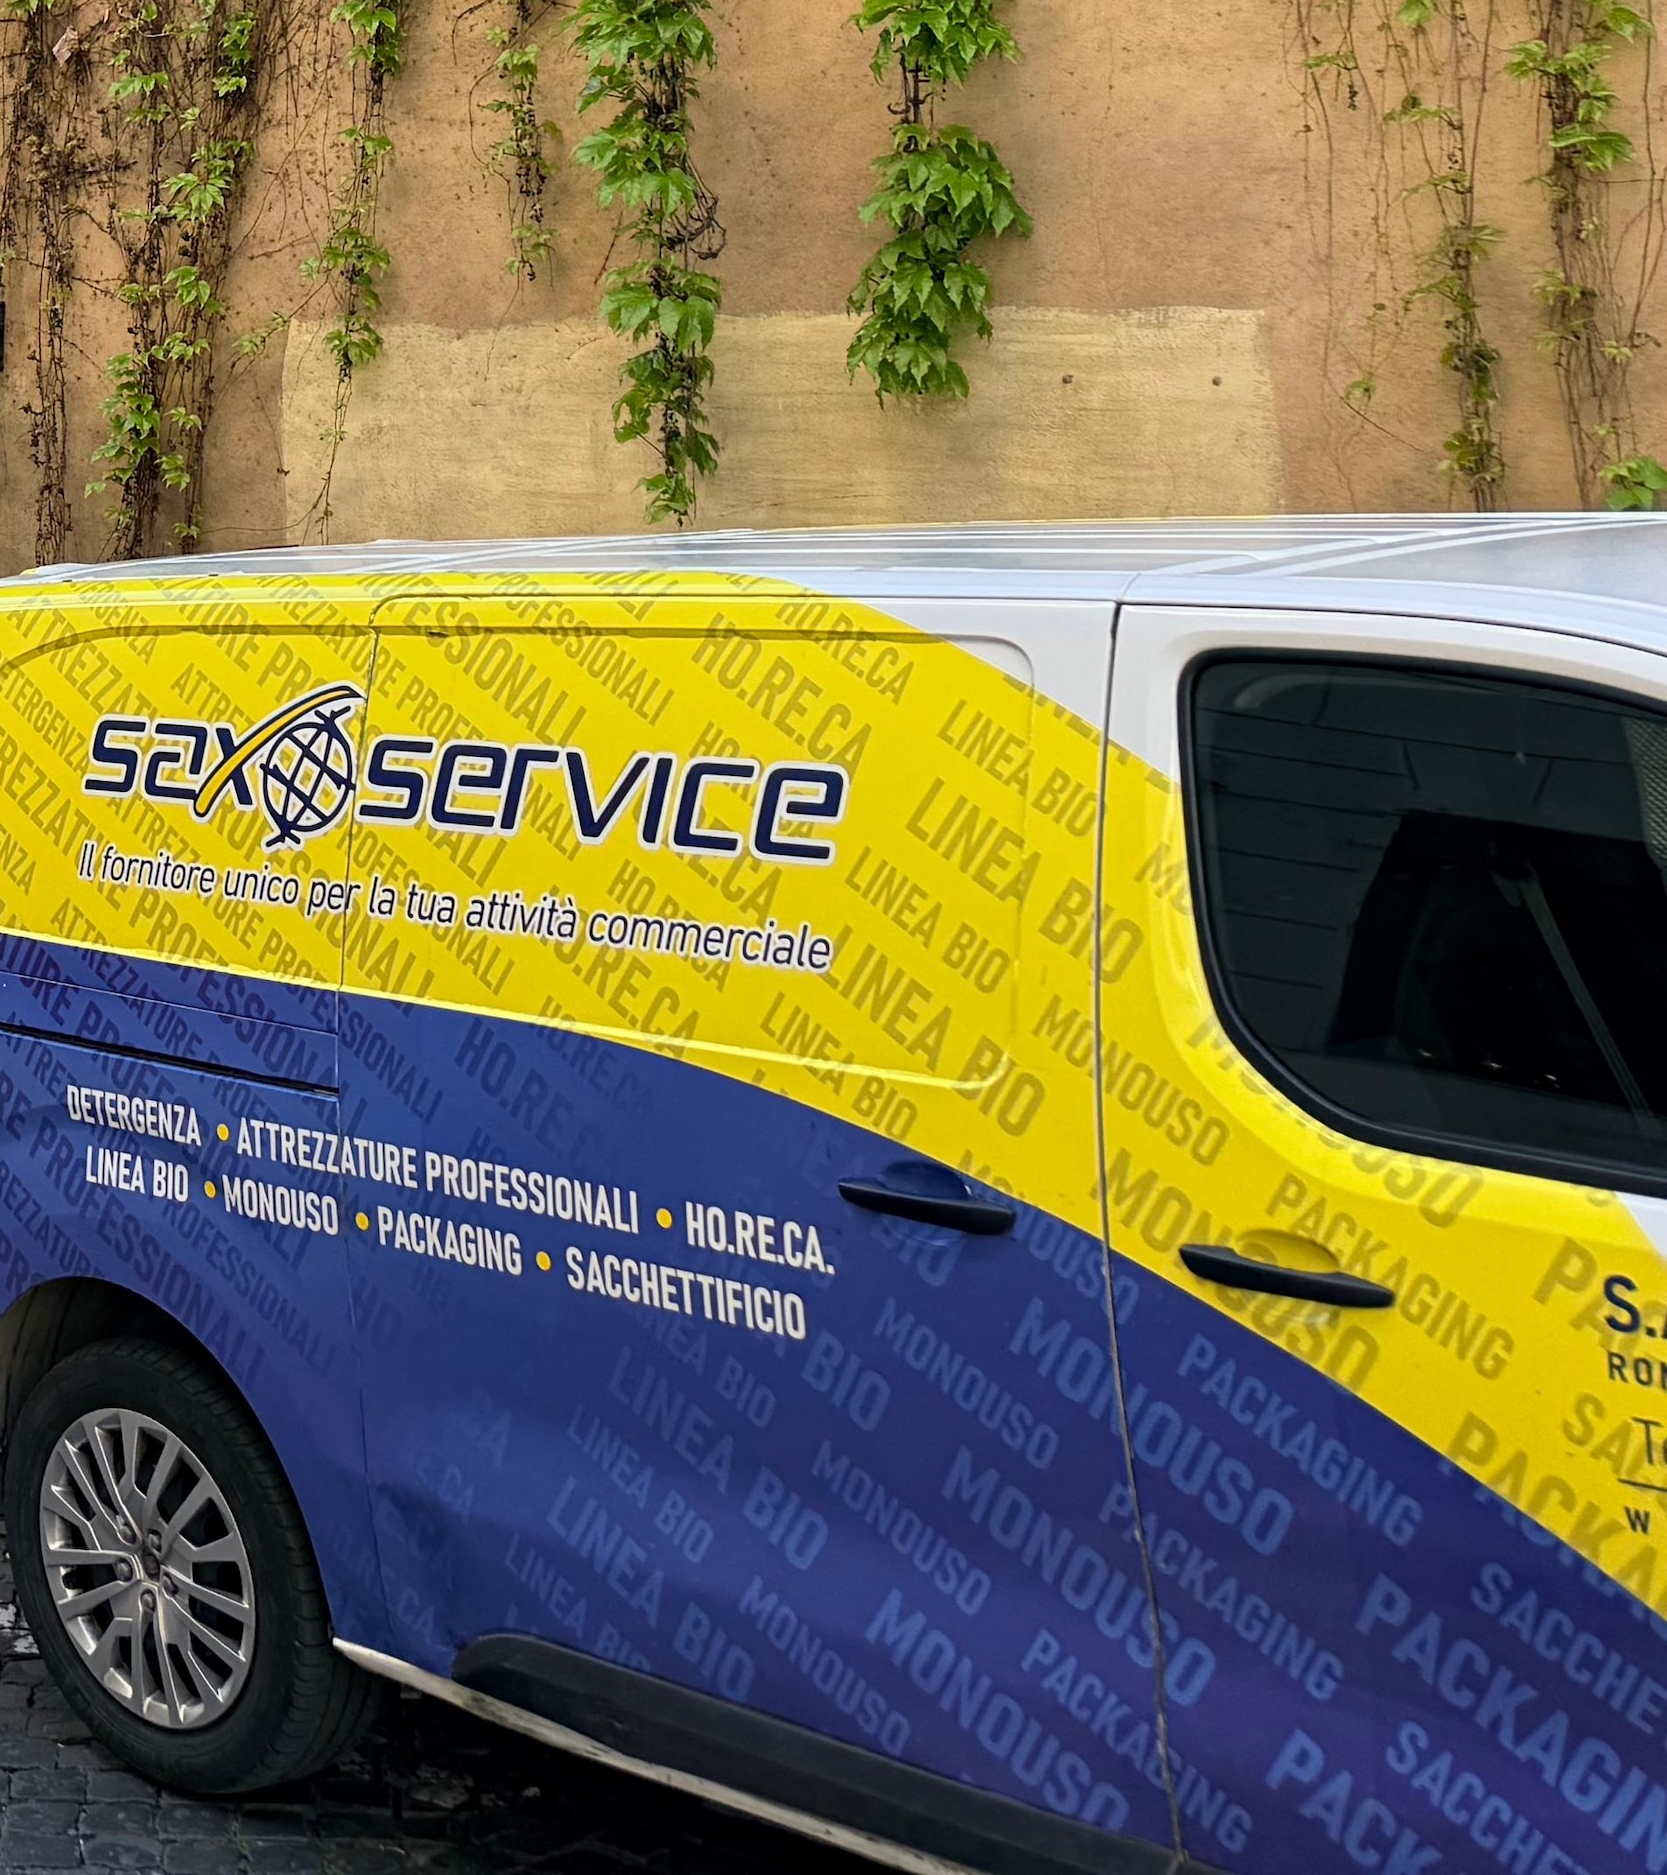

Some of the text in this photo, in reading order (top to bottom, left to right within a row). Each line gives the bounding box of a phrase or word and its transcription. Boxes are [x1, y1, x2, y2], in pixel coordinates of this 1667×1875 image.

[904, 775, 1042, 908] LINEA
[1038, 877, 1145, 984] BIO
[936, 698, 1035, 797] LINEA
[1030, 767, 1103, 838] BIO
[78, 843, 831, 970] Il fornitore unico per la tua attività commerciale
[843, 845, 944, 950] LINEA
[942, 921, 1011, 994] BIO
[1031, 992, 1230, 1166] MONOUSO
[67, 1085, 202, 1147] DETERGENZA
[237, 1117, 418, 1189] ATTREZZATURE
[425, 1151, 639, 1234] PROFESSIONALI
[685, 1201, 835, 1275] HO.RE.CA.
[954, 1034, 1047, 1137] BIO
[86, 1145, 807, 1341] LINEA BIO MONOUSO PACKAGING SACCHETTIFICIO
[851, 1075, 919, 1143] BIO
[1177, 1333, 1424, 1547] PACKAGING
[800, 1327, 892, 1433] BIO
[940, 1444, 1217, 1707] MONOUSO
[874, 1296, 1059, 1470] MONOUSO
[1098, 1481, 1345, 1701] PACKAGING
[1009, 1296, 1294, 1556] MONOUSO
[505, 1533, 588, 1641] LINEA
[545, 1474, 665, 1628] LINEA
[673, 1602, 755, 1703] BIO
[568, 1405, 655, 1510] LINEA
[654, 1490, 714, 1564] BIO
[738, 1574, 912, 1756] MONOUSO
[609, 1345, 734, 1495] LINEA
[742, 1466, 829, 1571] BIO
[865, 1587, 1131, 1833] MONOUSO
[715, 1355, 777, 1428] BIO
[811, 1438, 991, 1616] MONOUSO
[1020, 1628, 1253, 1855] PACKAGING
